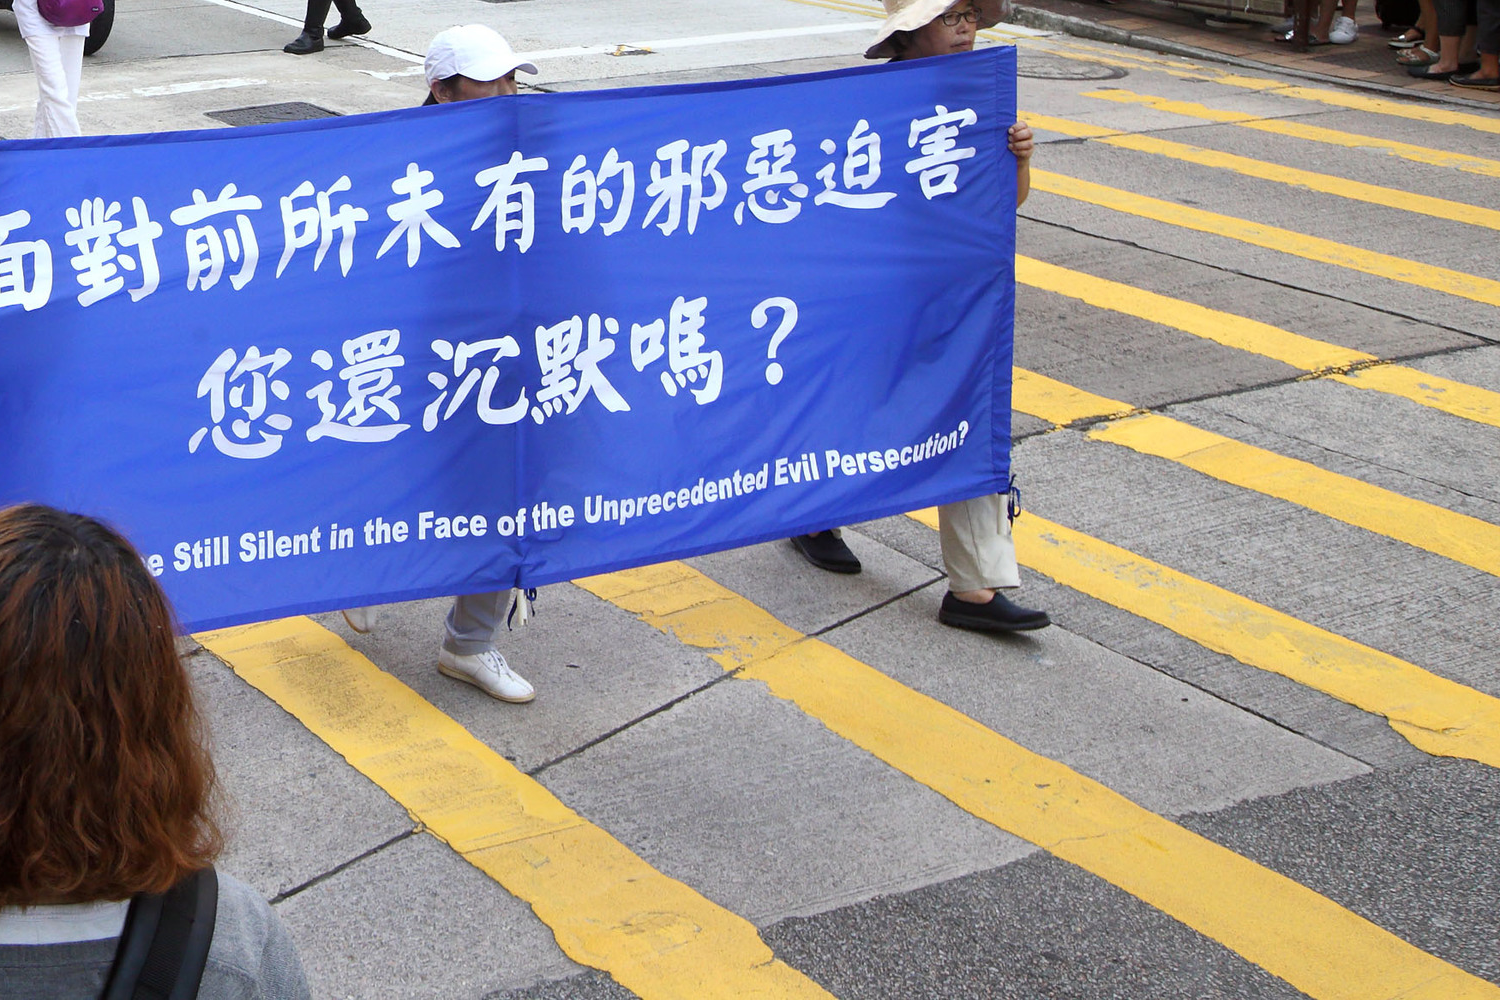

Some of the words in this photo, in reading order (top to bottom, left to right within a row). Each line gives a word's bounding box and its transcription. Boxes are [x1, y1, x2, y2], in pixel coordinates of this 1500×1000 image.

[173, 537, 230, 572] Still
[238, 524, 321, 562] Silent
[330, 522, 354, 550] in
[363, 515, 408, 545] the
[419, 508, 487, 540] Face
[498, 507, 526, 537] of
[533, 502, 574, 532] the
[584, 463, 768, 525] Unprecedented
[775, 452, 820, 488] Evil
[827, 420, 970, 477] Persecution?
